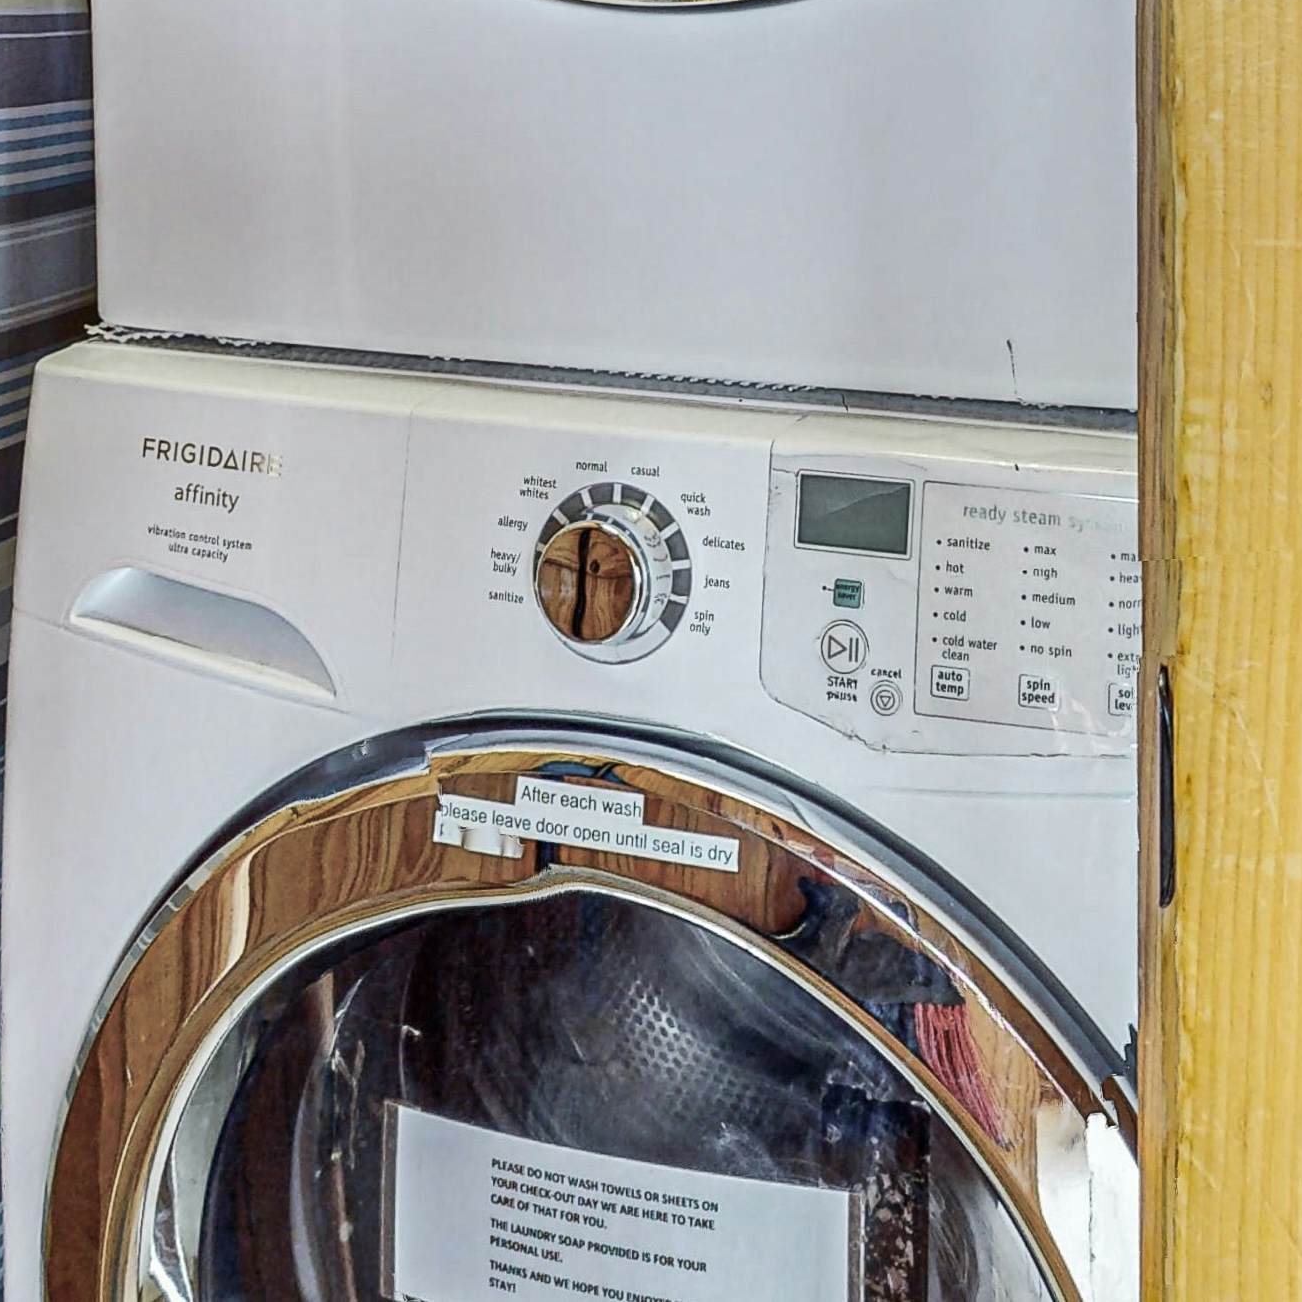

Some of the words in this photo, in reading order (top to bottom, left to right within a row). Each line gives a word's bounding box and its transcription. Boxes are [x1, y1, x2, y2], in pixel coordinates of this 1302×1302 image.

[576, 461, 607, 473] normal
[631, 465, 660, 477] casual
[523, 476, 557, 489] whitest
[174, 482, 239, 514] affinity
[519, 488, 549, 500] whites
[680, 492, 706, 504] quick
[687, 505, 711, 516] wash
[962, 504, 1006, 525] ready
[1013, 510, 1061, 527] steam
[498, 515, 528, 531] allergy
[148, 524, 186, 539] vibration
[189, 532, 219, 546] control
[222, 538, 252, 550] system
[702, 535, 746, 551] delicates
[947, 537, 990, 551] sanitize
[168, 543, 188, 555] ultra
[191, 547, 228, 563] capacity
[490, 548, 521, 564] heavy/
[1034, 545, 1057, 556] max
[1120, 552, 1138, 563] ma
[493, 562, 517, 576] bulky
[945, 560, 964, 574] hot
[704, 574, 730, 589] jeans
[1119, 572, 1141, 584] hea
[488, 590, 524, 604] sanitize
[944, 585, 973, 597] warm
[1032, 593, 1076, 606] medium
[694, 610, 714, 622] spin
[943, 610, 967, 622] cold
[1031, 616, 1050, 629] low
[689, 622, 711, 635] only
[1117, 624, 1141, 639] ligh
[942, 636, 965, 647] cold
[968, 639, 998, 651] water
[942, 648, 970, 661] clean
[1030, 644, 1044, 655] no
[1048, 645, 1072, 659] spin
[870, 667, 902, 679] cancel
[938, 670, 963, 682] auto
[826, 676, 858, 689] START
[936, 682, 964, 696] temp
[1026, 678, 1051, 691] spin
[1021, 691, 1055, 705] speed
[521, 785, 556, 805] After
[560, 794, 596, 811] each
[602, 799, 642, 818] wash
[441, 802, 487, 823] please
[492, 810, 532, 831] leave
[536, 818, 569, 837] door
[573, 826, 610, 843] open
[616, 832, 647, 849] until
[652, 839, 685, 856] seal
[690, 841, 703, 859] is
[707, 845, 733, 865] dry
[491, 1158, 525, 1176] PLEASE
[527, 1167, 542, 1179] DO
[544, 1171, 565, 1185] NOT
[568, 1176, 598, 1191] WASH
[600, 1182, 641, 1200] TOWELS
[644, 1191, 659, 1202] OR
[662, 1194, 699, 1210] SHEETS
[702, 1201, 719, 1213] ON
[491, 1176, 518, 1191] YOUR
[520, 1183, 575, 1205] CHECK-OUT
[578, 1196, 598, 1210] DAY
[600, 1201, 617, 1214] WE
[619, 1205, 640, 1217] ARE
[642, 1209, 668, 1223] HERE
[671, 1214, 686, 1225] TO
[688, 1216, 715, 1230] TAKE
[490, 1194, 515, 1209] CARE
[517, 1200, 529, 1211] OF
[532, 1204, 558, 1218] THAT
[560, 1210, 580, 1223] FOR
[582, 1215, 607, 1230] YOU.
[489, 1235, 539, 1257] PERSONAL
[541, 1249, 563, 1263] USE.
[490, 1217, 508, 1232] THE
[510, 1223, 556, 1243] LAUNDRY
[558, 1235, 585, 1249] SOAP
[587, 1241, 640, 1261] PROVIDED
[642, 1252, 651, 1263] IS
[653, 1254, 674, 1267] FOR
[677, 1258, 707, 1272] YOUR
[489, 1260, 527, 1279] THANKS
[529, 1271, 551, 1285] AND
[553, 1277, 570, 1291] WE
[572, 1281, 599, 1296] HOPE
[602, 1286, 624, 1301] YOU
[489, 1277, 516, 1293] STAY!
